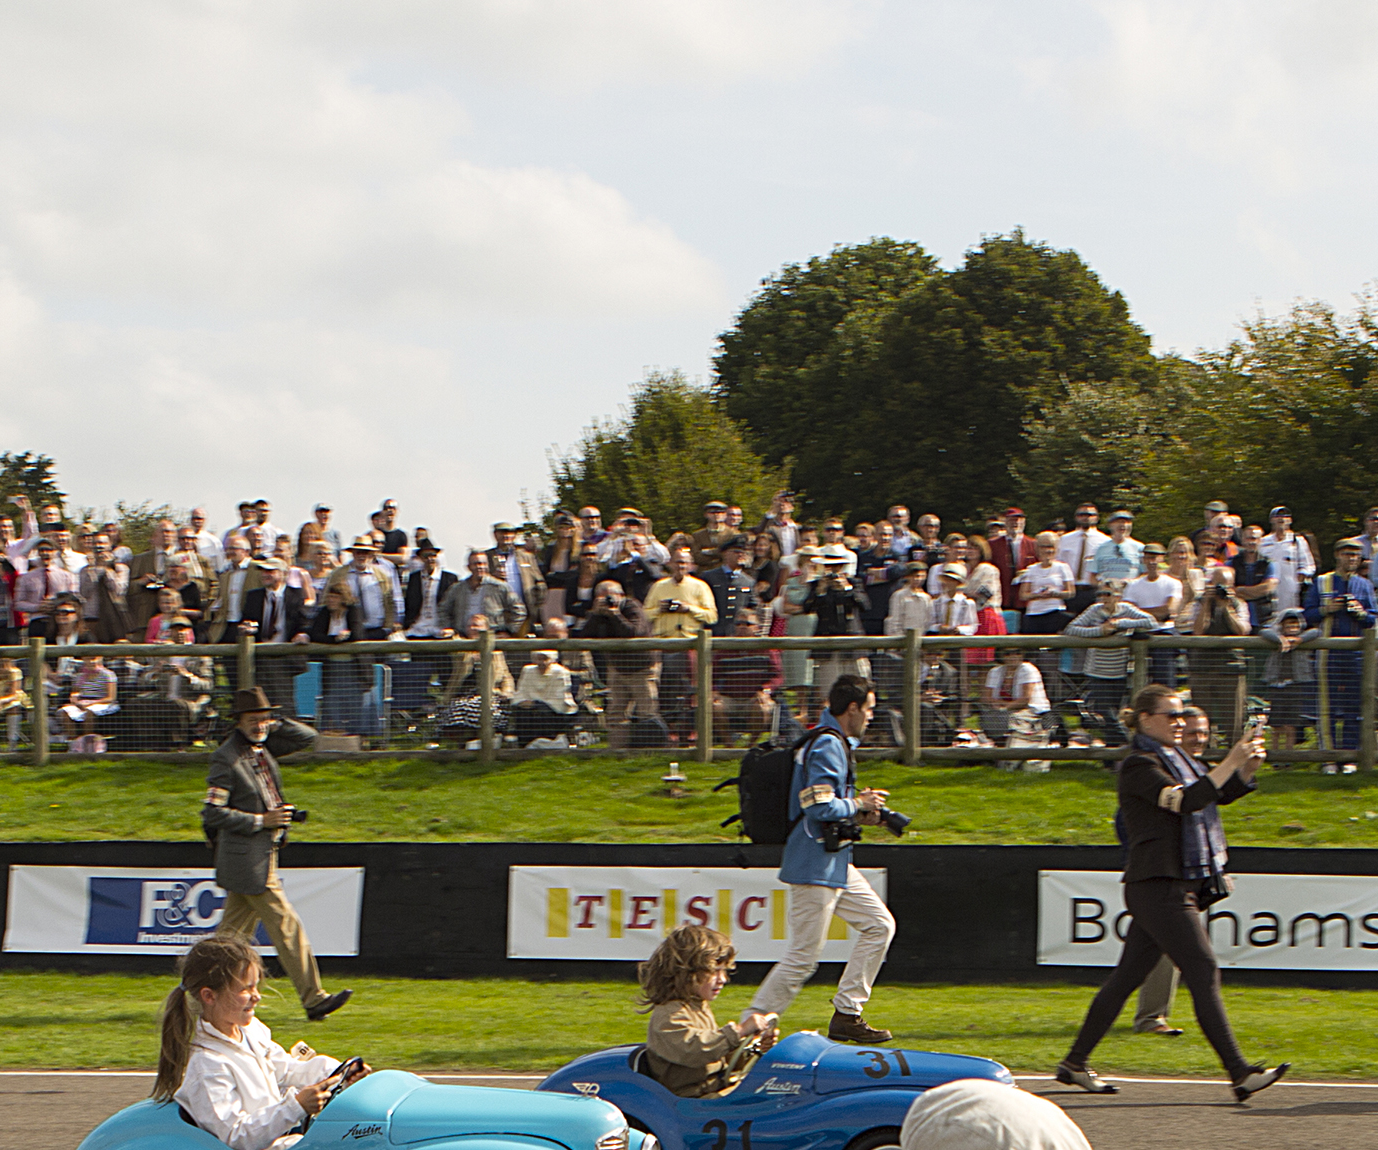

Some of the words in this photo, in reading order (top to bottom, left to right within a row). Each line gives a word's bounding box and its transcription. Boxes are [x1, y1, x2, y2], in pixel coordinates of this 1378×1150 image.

[139, 880, 228, 929] F&C
[574, 895, 769, 931] TESC
[856, 1050, 912, 1079] 31
[755, 1076, 801, 1094] Austin
[342, 1123, 384, 1140] Austin
